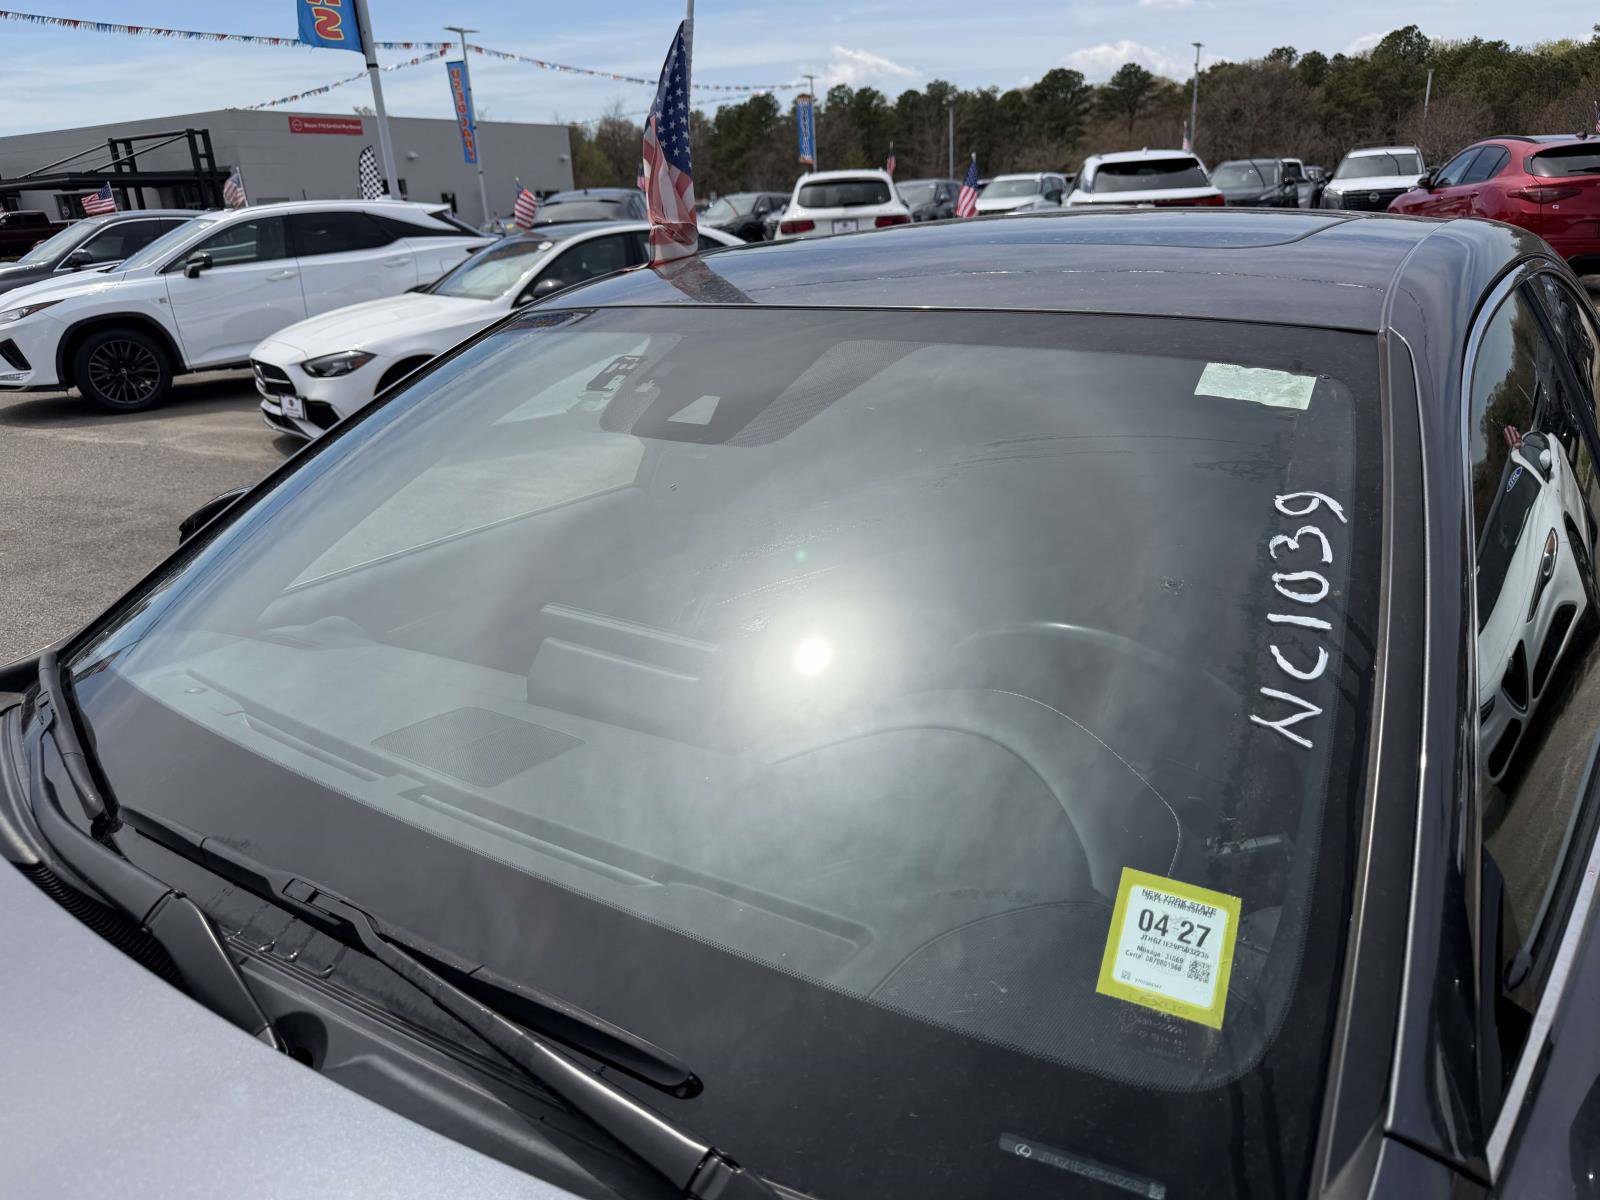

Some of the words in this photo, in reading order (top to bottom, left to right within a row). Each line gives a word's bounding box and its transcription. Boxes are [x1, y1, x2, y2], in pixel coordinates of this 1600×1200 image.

[1249, 490, 1348, 749] NC1039
[1142, 888, 1161, 900] NEW
[1163, 894, 1188, 908] YORK
[1190, 900, 1217, 916] STATE
[1138, 908, 1170, 937] 04
[1177, 920, 1212, 948] 27
